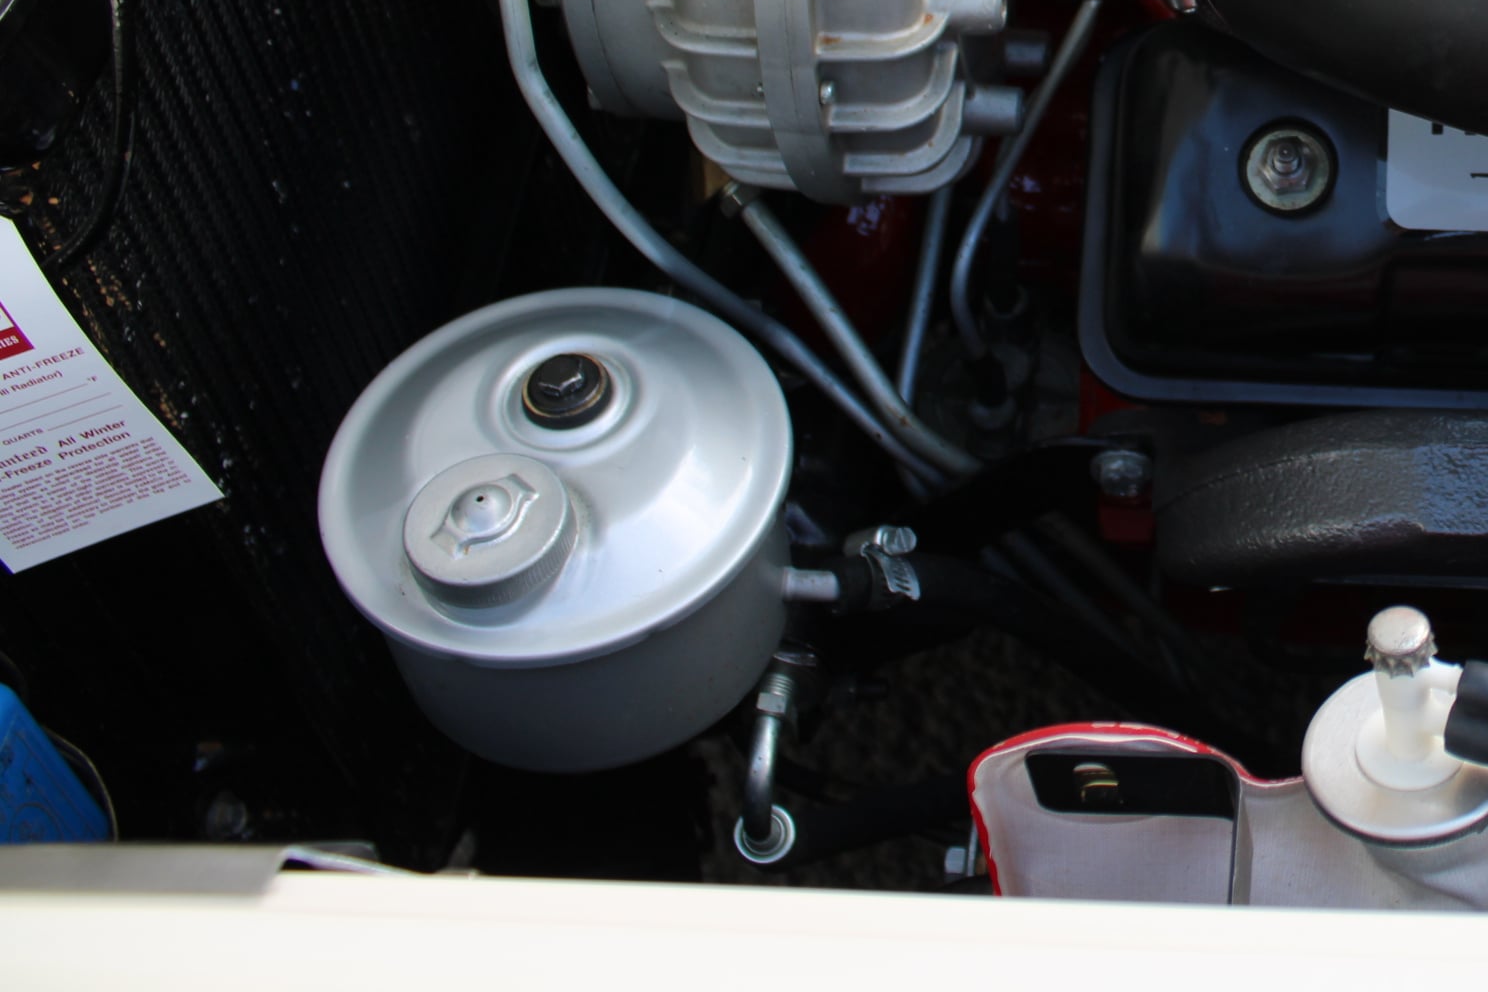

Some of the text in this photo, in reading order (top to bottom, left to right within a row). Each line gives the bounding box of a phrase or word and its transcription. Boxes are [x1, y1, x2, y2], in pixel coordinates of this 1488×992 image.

[0, 335, 20, 349] IES
[3, 347, 84, 380] ANTI-FREEZE
[11, 370, 63, 392] Radiator)
[3, 428, 43, 445] QUARTS
[58, 436, 76, 448] All
[80, 421, 125, 439] Winter
[58, 432, 130, 460] Protection
